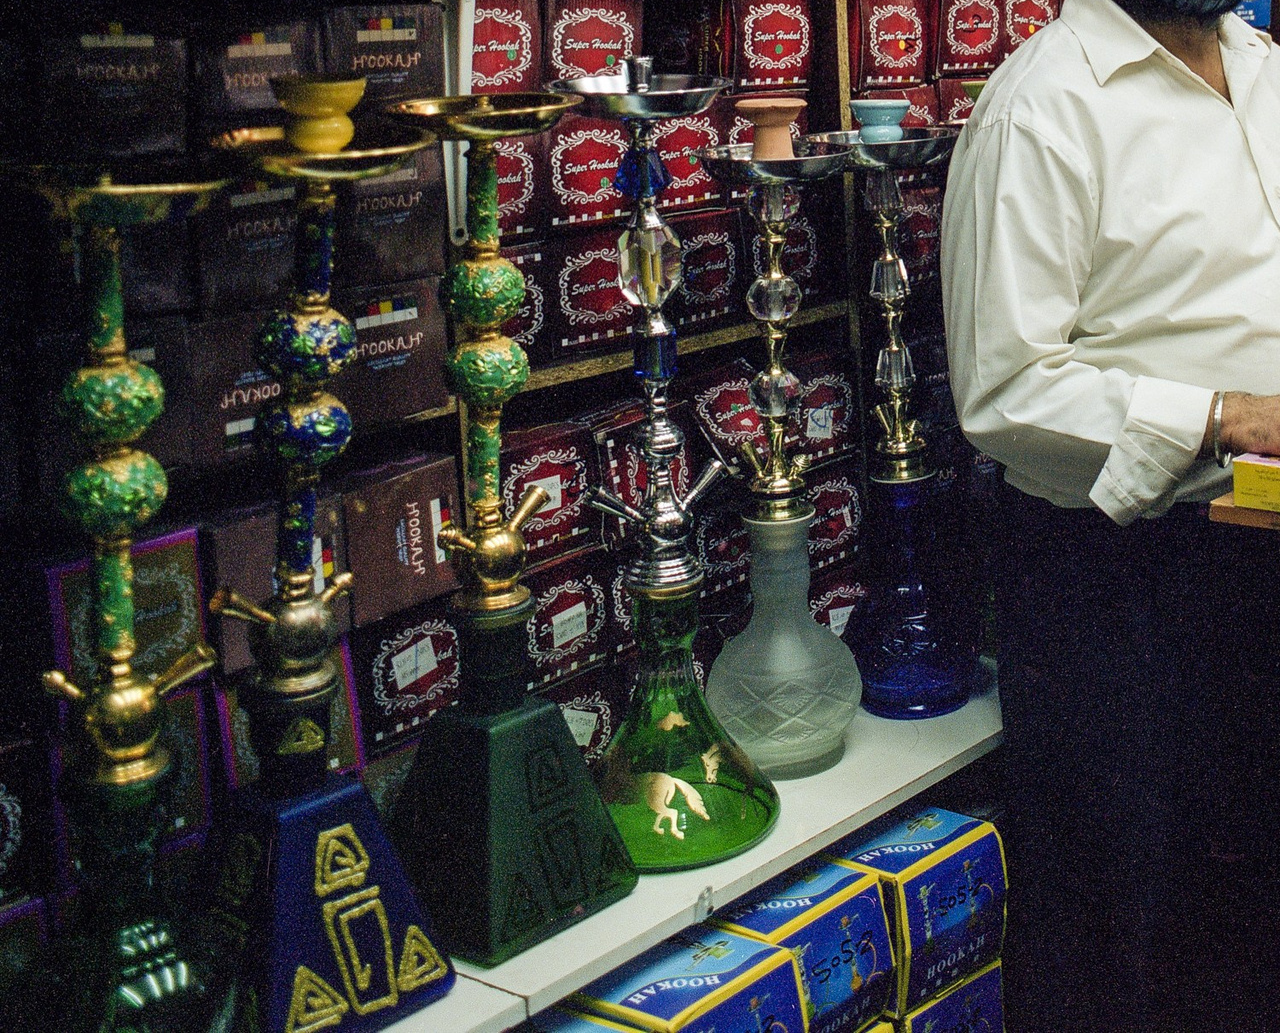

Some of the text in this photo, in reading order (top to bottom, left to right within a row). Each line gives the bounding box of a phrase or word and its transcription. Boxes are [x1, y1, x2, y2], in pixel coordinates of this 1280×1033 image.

[1013, 13, 1048, 27] Super Hookah
[754, 30, 801, 43] Super Hookah
[878, 30, 916, 41] Super Hookah
[472, 40, 521, 54] per Hookah
[564, 39, 622, 50] Super Hookah
[354, 52, 422, 71] HOOKAH
[660, 149, 678, 161] Super
[564, 158, 619, 175] Super Hookah
[497, 172, 522, 184] ookah
[357, 191, 423, 213] HOOKAH
[705, 261, 727, 271] Hookah
[571, 278, 620, 296] Super Hook
[354, 332, 425, 356] HOOKAH
[221, 383, 281, 410] OOKAH
[405, 501, 426, 575] HOOKAH
[856, 841, 937, 864] HOOKAH
[925, 933, 986, 980] HOOKAH
[627, 974, 722, 1005] HOOKAH
